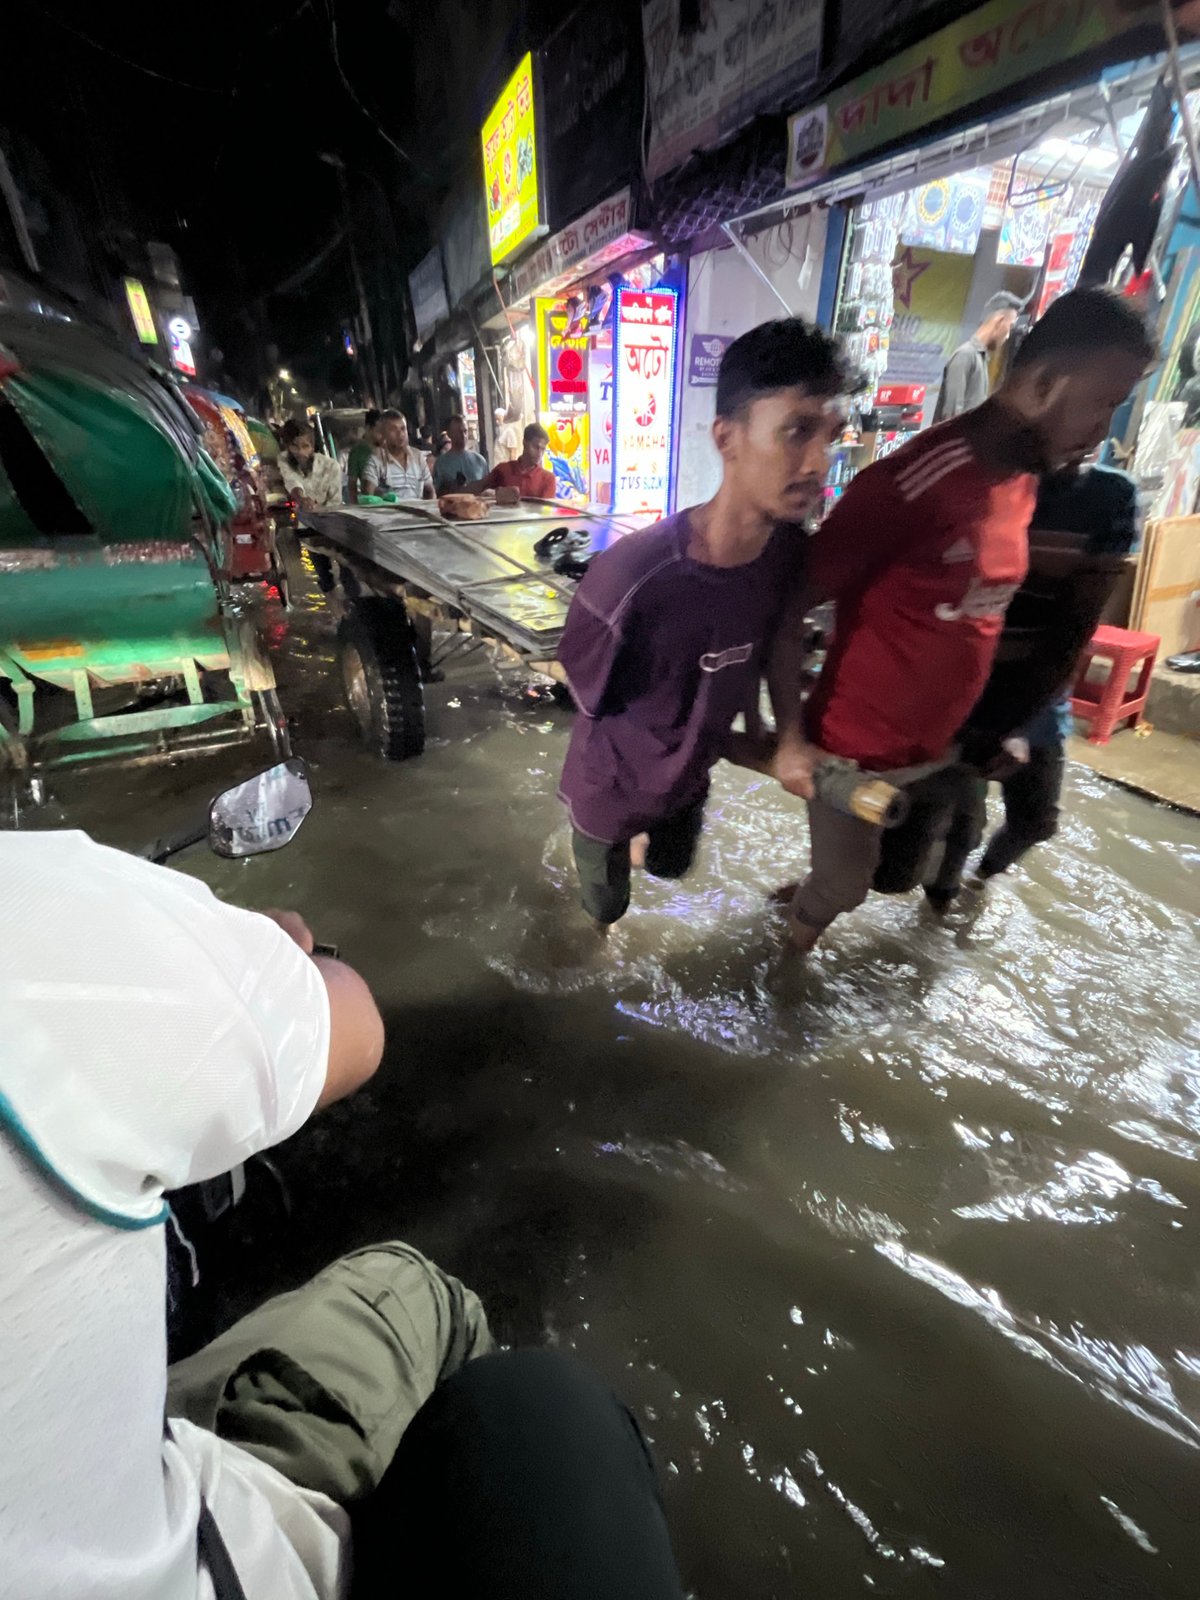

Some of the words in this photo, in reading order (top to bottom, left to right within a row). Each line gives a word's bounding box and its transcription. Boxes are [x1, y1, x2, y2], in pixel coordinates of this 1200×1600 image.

[840, 55, 935, 131] দাদা
[624, 334, 670, 380] অটো
[620, 476, 641, 490] TVS
